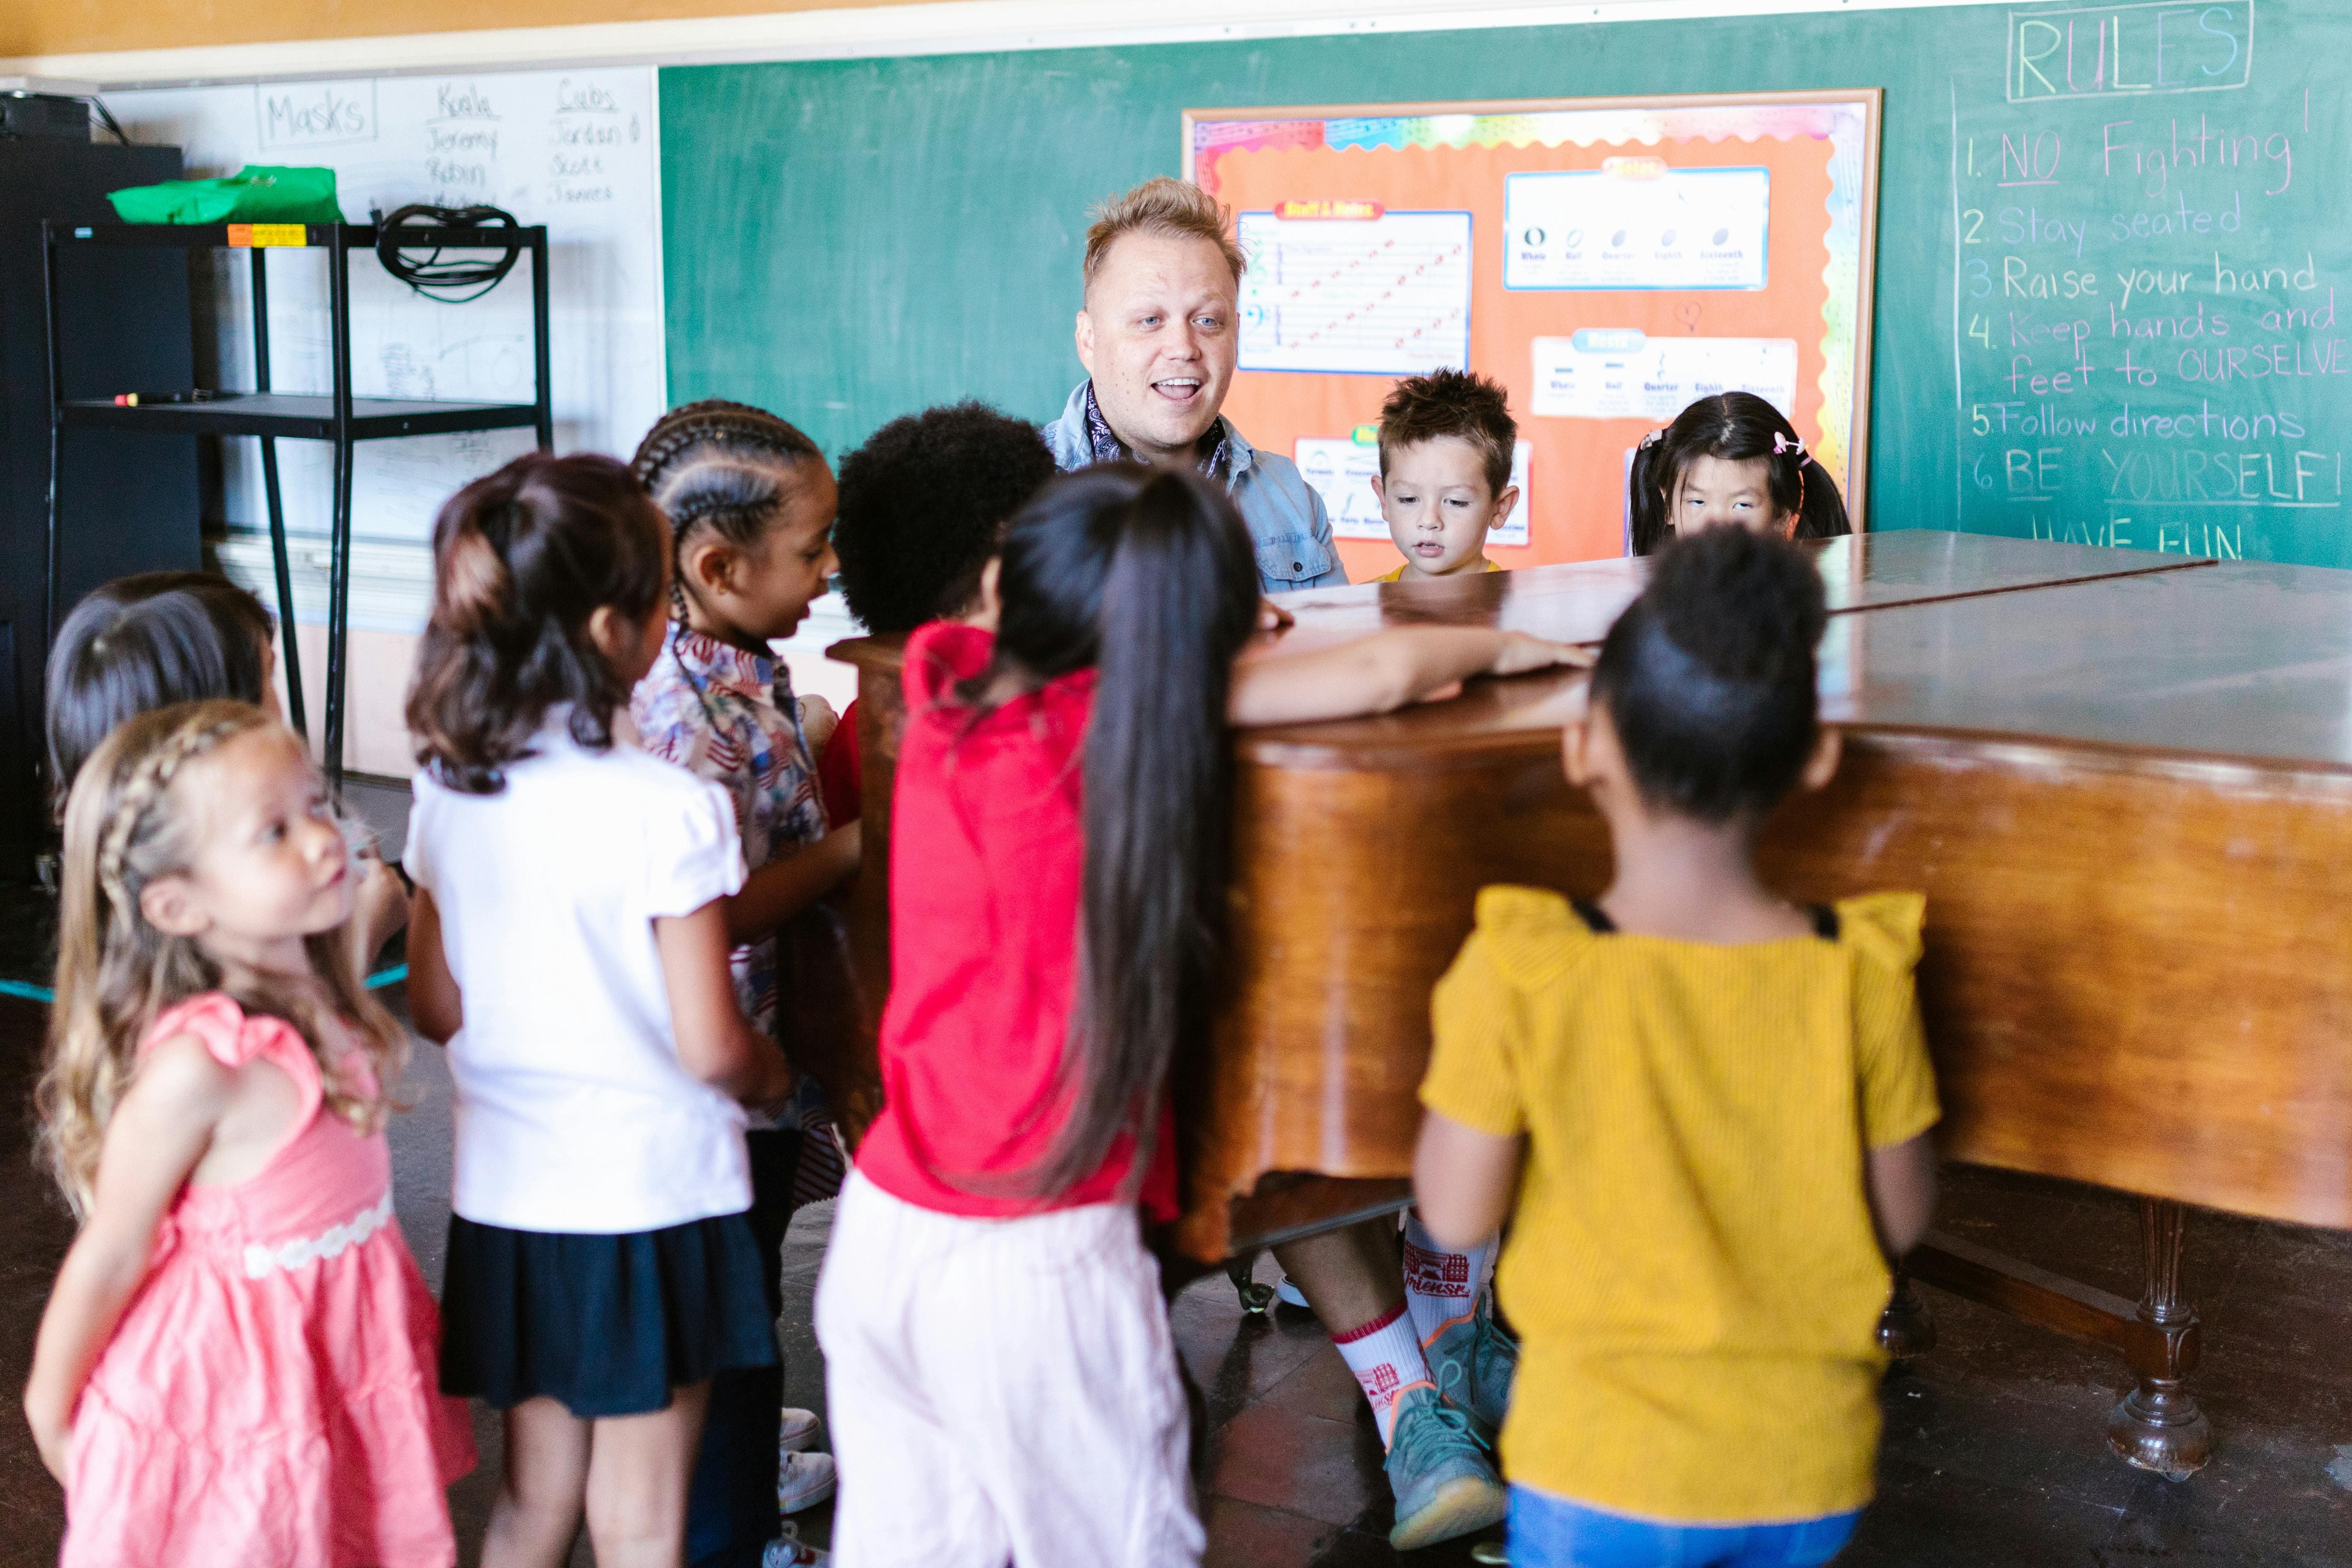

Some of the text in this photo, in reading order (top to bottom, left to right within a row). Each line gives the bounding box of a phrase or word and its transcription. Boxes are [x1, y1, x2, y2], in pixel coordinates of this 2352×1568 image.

[2019, 7, 2238, 98] RULES
[267, 88, 365, 141] Masks
[557, 78, 616, 109] Cubs
[1967, 136, 1982, 178] 1.
[2002, 130, 2061, 180] NO
[1998, 206, 2085, 257] Stay
[2112, 190, 2242, 241] seated
[2004, 256, 2098, 300] Raise
[2117, 267, 2193, 311] your
[2215, 251, 2317, 295] hand
[1968, 287, 2335, 361] 4. Keep hands and
[2004, 338, 2350, 394] feet to OURSELVE
[1990, 401, 2097, 436] Follow
[2110, 398, 2306, 441] directions
[2006, 447, 2063, 493] BE
